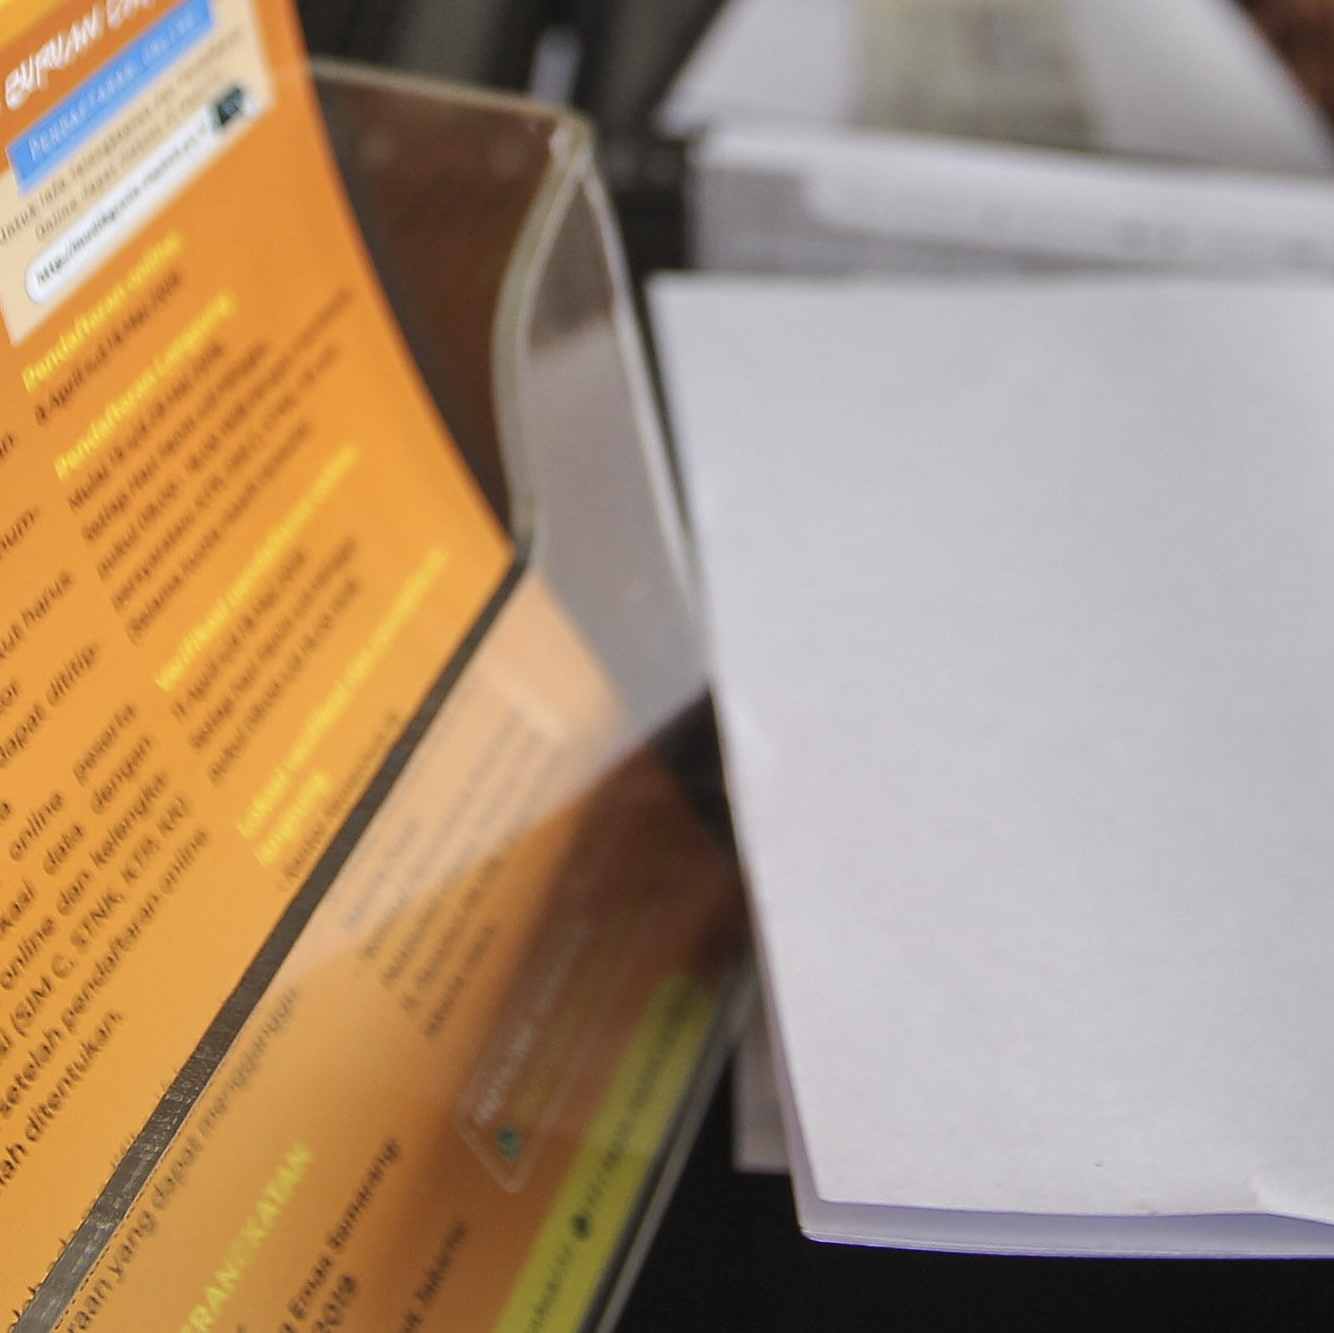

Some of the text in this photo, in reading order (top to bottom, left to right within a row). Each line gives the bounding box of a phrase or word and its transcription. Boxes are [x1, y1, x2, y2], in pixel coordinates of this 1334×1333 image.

[19, 570, 73, 629] harus
[8, 792, 64, 861] online
[42, 823, 84, 875] data
[55, 869, 90, 916] dan
[106, 1209, 156, 1284] yang
